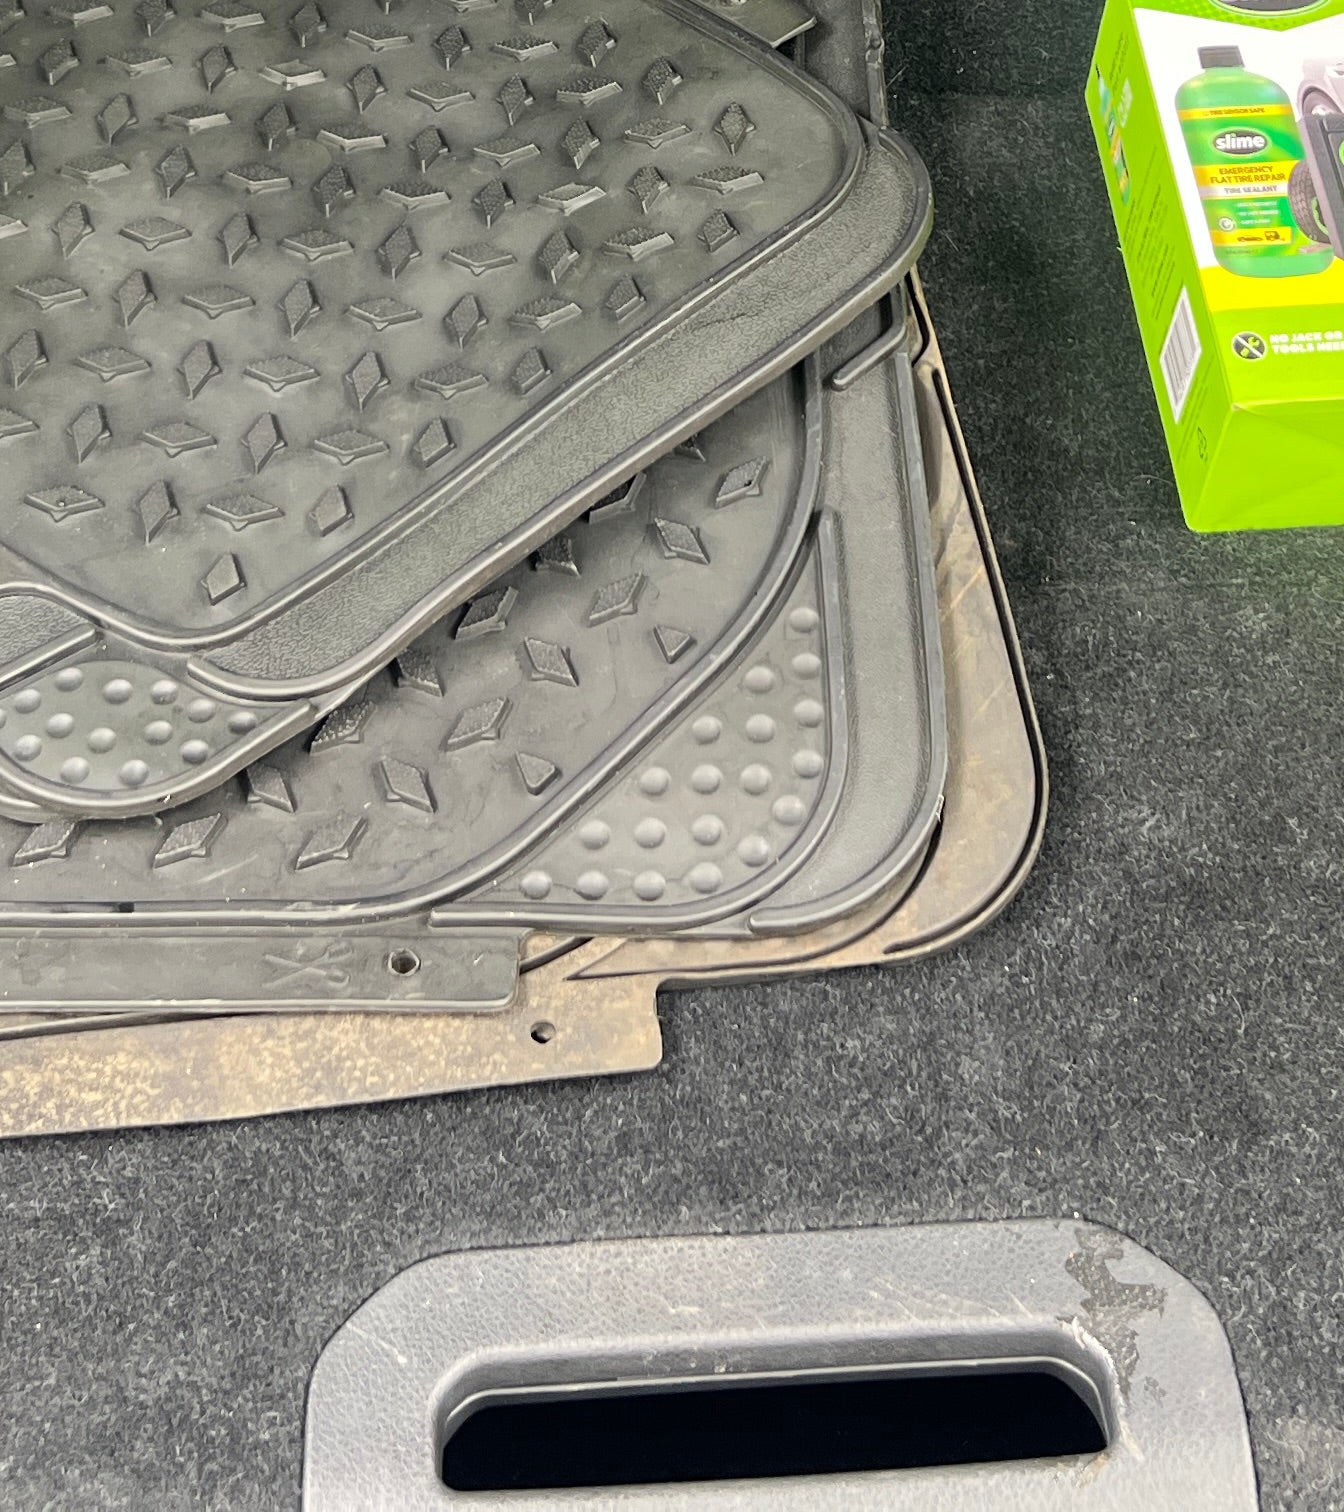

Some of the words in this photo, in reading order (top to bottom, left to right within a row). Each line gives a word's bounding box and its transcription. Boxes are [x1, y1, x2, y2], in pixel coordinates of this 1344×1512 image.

[1215, 133, 1266, 150] slime
[1219, 166, 1273, 176] EMERGENCY
[1210, 175, 1234, 184] FLAT
[1234, 174, 1254, 184] TIRE
[1254, 173, 1286, 182] REPAIR
[1224, 186, 1242, 194] TIRE
[1243, 185, 1278, 193] SEALANT
[1269, 334, 1289, 344] NO
[1291, 332, 1322, 342] JACK
[1272, 343, 1315, 354] TOOLS
